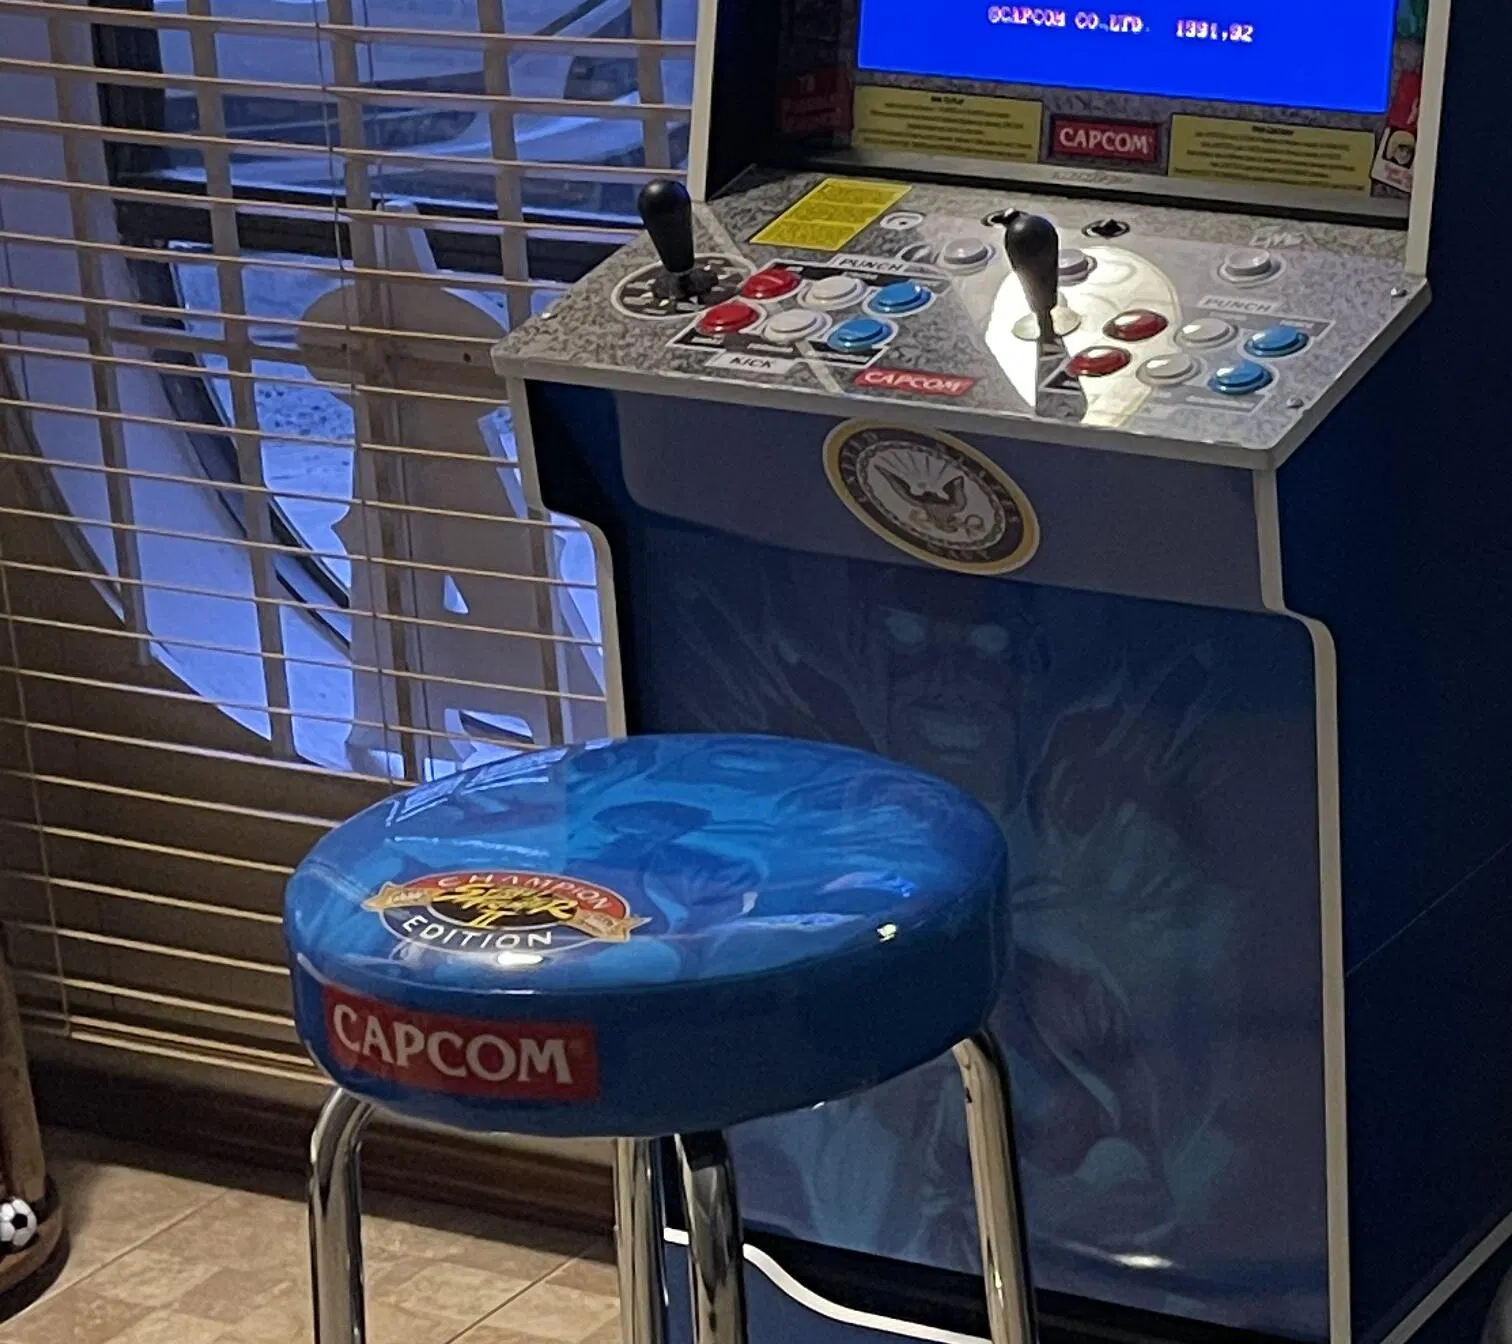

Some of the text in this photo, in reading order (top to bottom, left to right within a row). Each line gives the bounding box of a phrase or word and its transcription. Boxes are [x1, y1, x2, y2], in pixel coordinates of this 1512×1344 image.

[1060, 126, 1150, 156] CAPCOM
[839, 257, 904, 272] PUNCH
[1204, 297, 1273, 312] PUNCH
[731, 355, 775, 369] KICK
[864, 371, 963, 394] CAPCOM
[438, 874, 611, 910] CHAMPION
[402, 914, 552, 949] EDITION
[333, 1004, 574, 1085] CAPCOM
